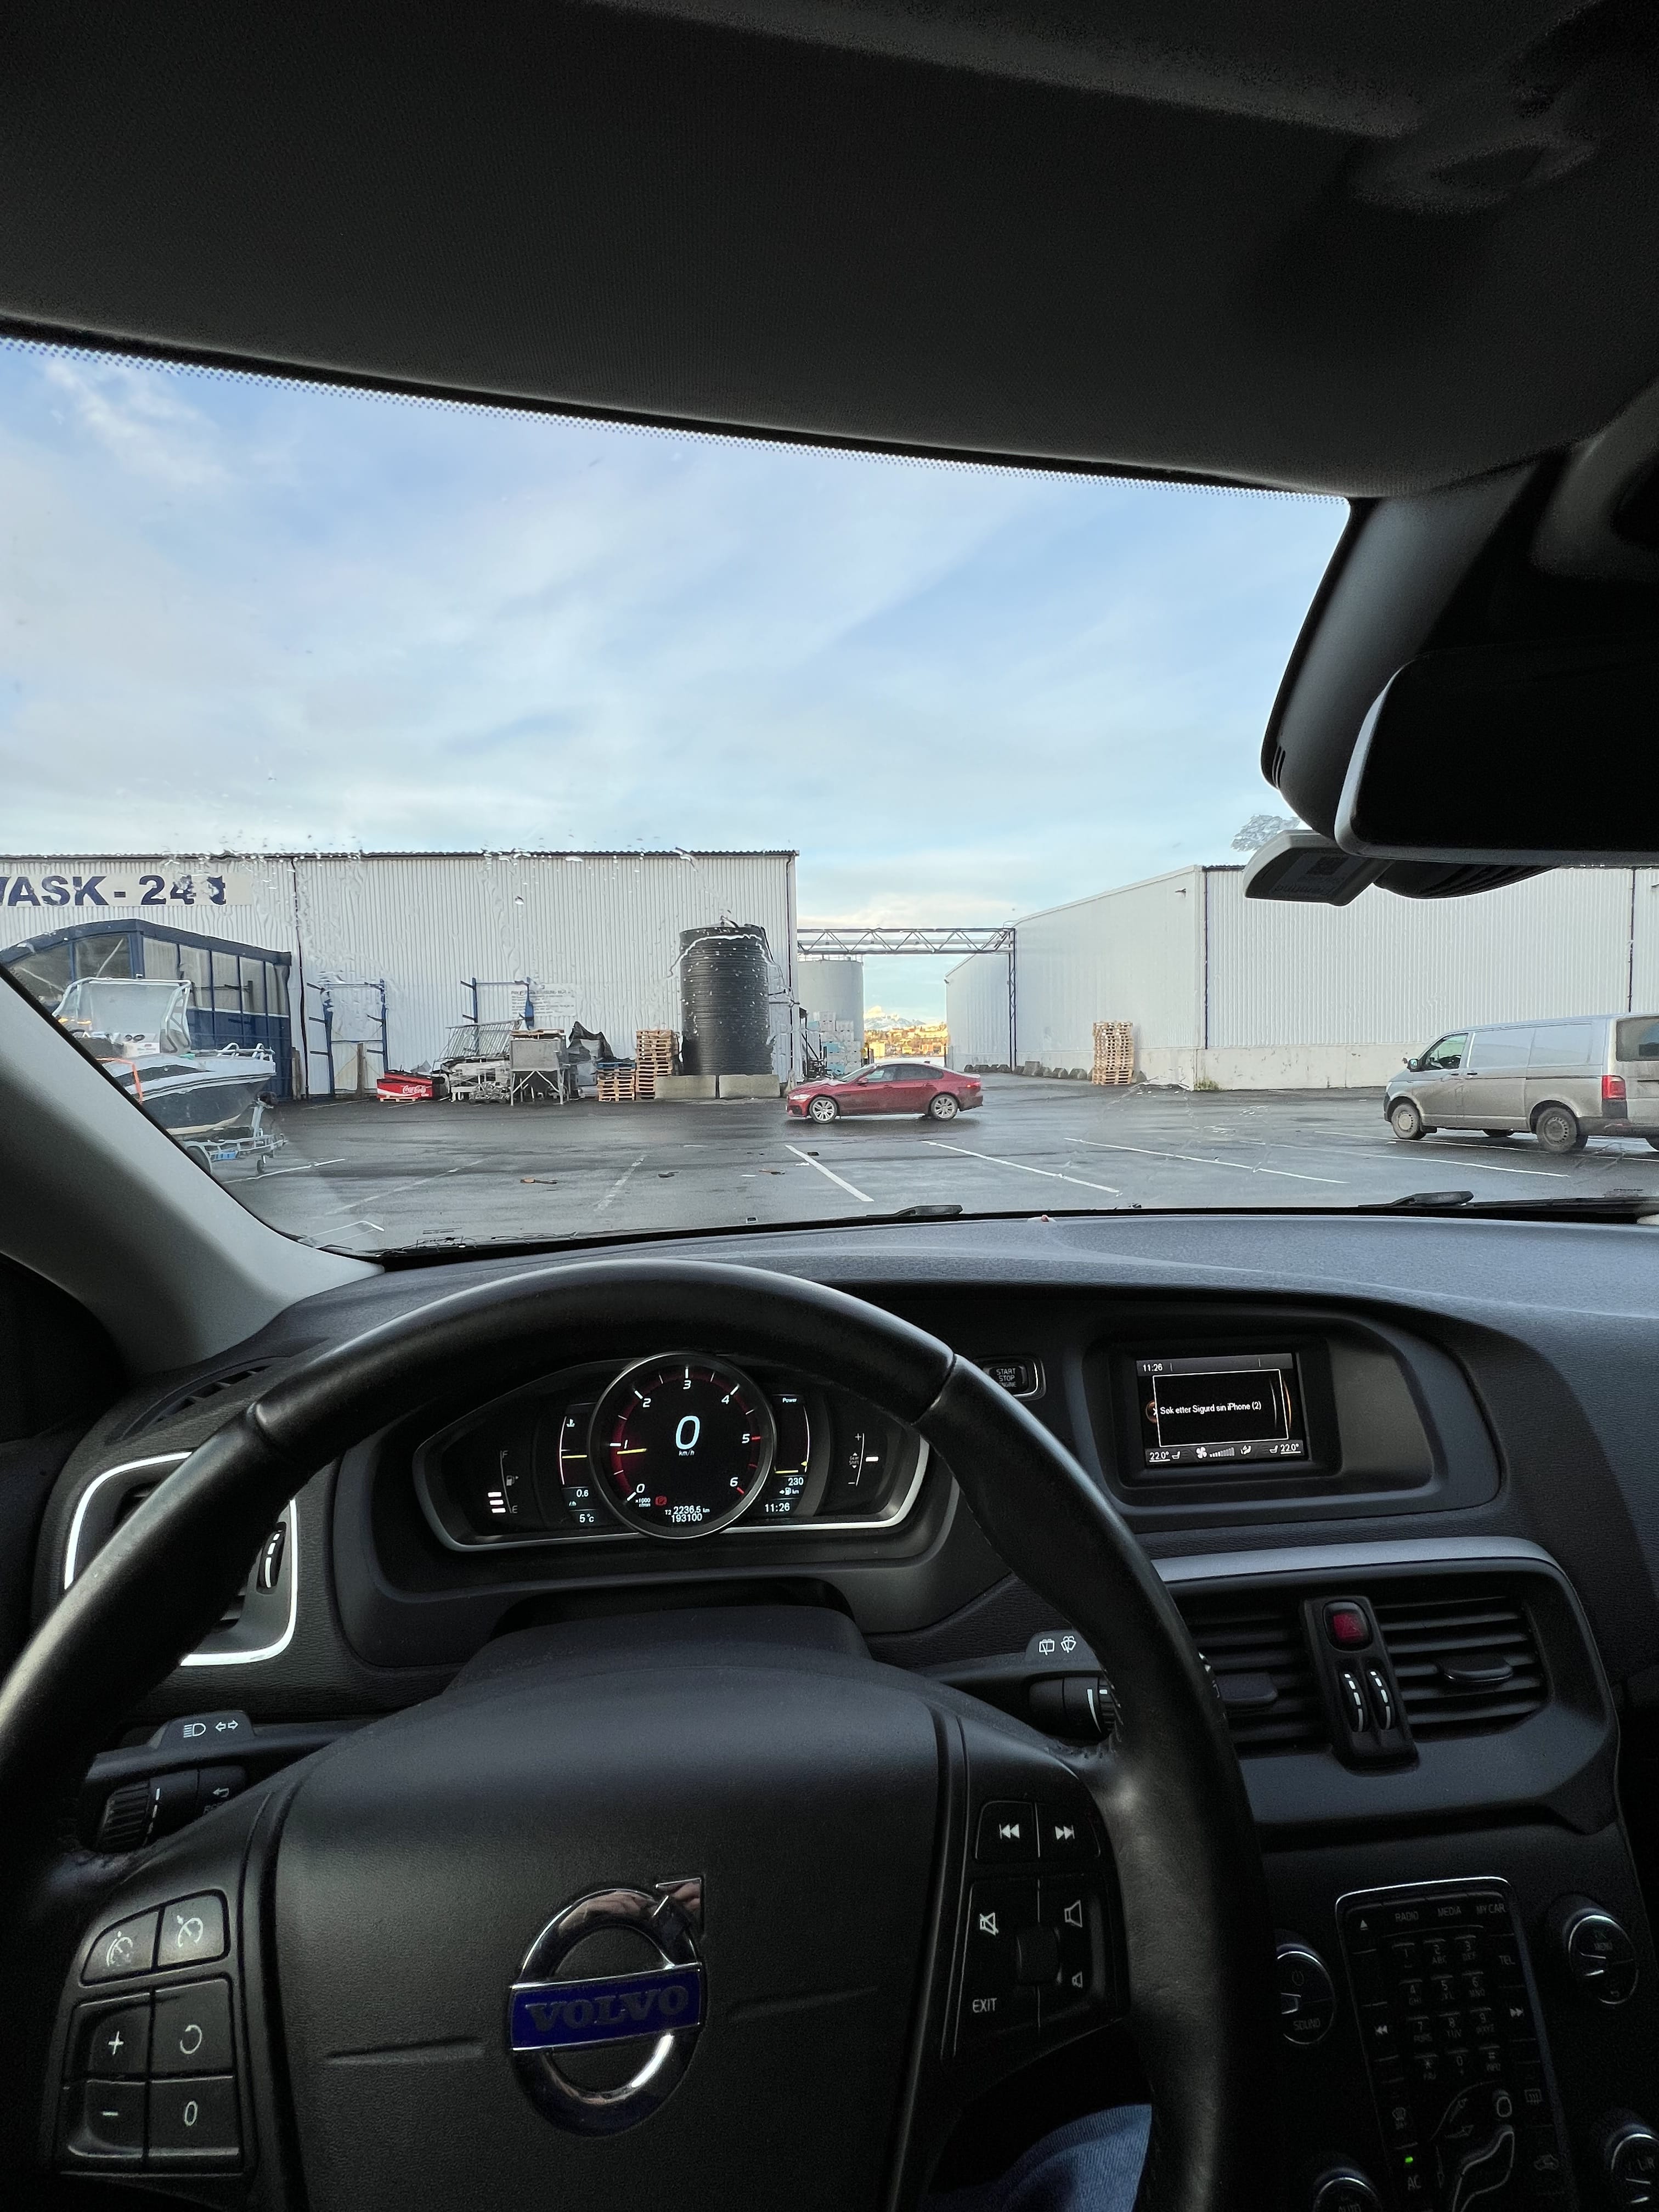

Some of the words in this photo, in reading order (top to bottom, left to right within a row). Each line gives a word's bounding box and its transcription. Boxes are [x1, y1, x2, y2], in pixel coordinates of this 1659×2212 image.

[1143, 1363, 1163, 1372] 11:26
[682, 1380, 691, 1390] 3
[642, 1398, 651, 1408] 2
[721, 1395, 730, 1404] 4
[1192, 1404, 1215, 1414] Sigurd
[1216, 1403, 1227, 1412] sin
[1227, 1402, 1251, 1411] iPhone
[1252, 1401, 1262, 1410] (2)
[675, 1415, 701, 1449] 0
[742, 1434, 751, 1443] 5
[623, 1440, 629, 1449] 1
[730, 1477, 738, 1487] 6
[788, 1477, 804, 1486] 230
[636, 1483, 645, 1493] 0
[765, 1502, 790, 1513] 11:26
[671, 1513, 702, 1523] 193100
[1437, 1905, 1462, 1917] MEDIA
[1488, 1903, 1507, 1914] CAR
[1395, 1911, 1419, 1922] RADIO
[1498, 1955, 1516, 1966] TEL
[524, 1985, 690, 2032] VOLVO
[972, 1997, 997, 2013] EXIT
[1407, 2174, 1422, 2191] AC
